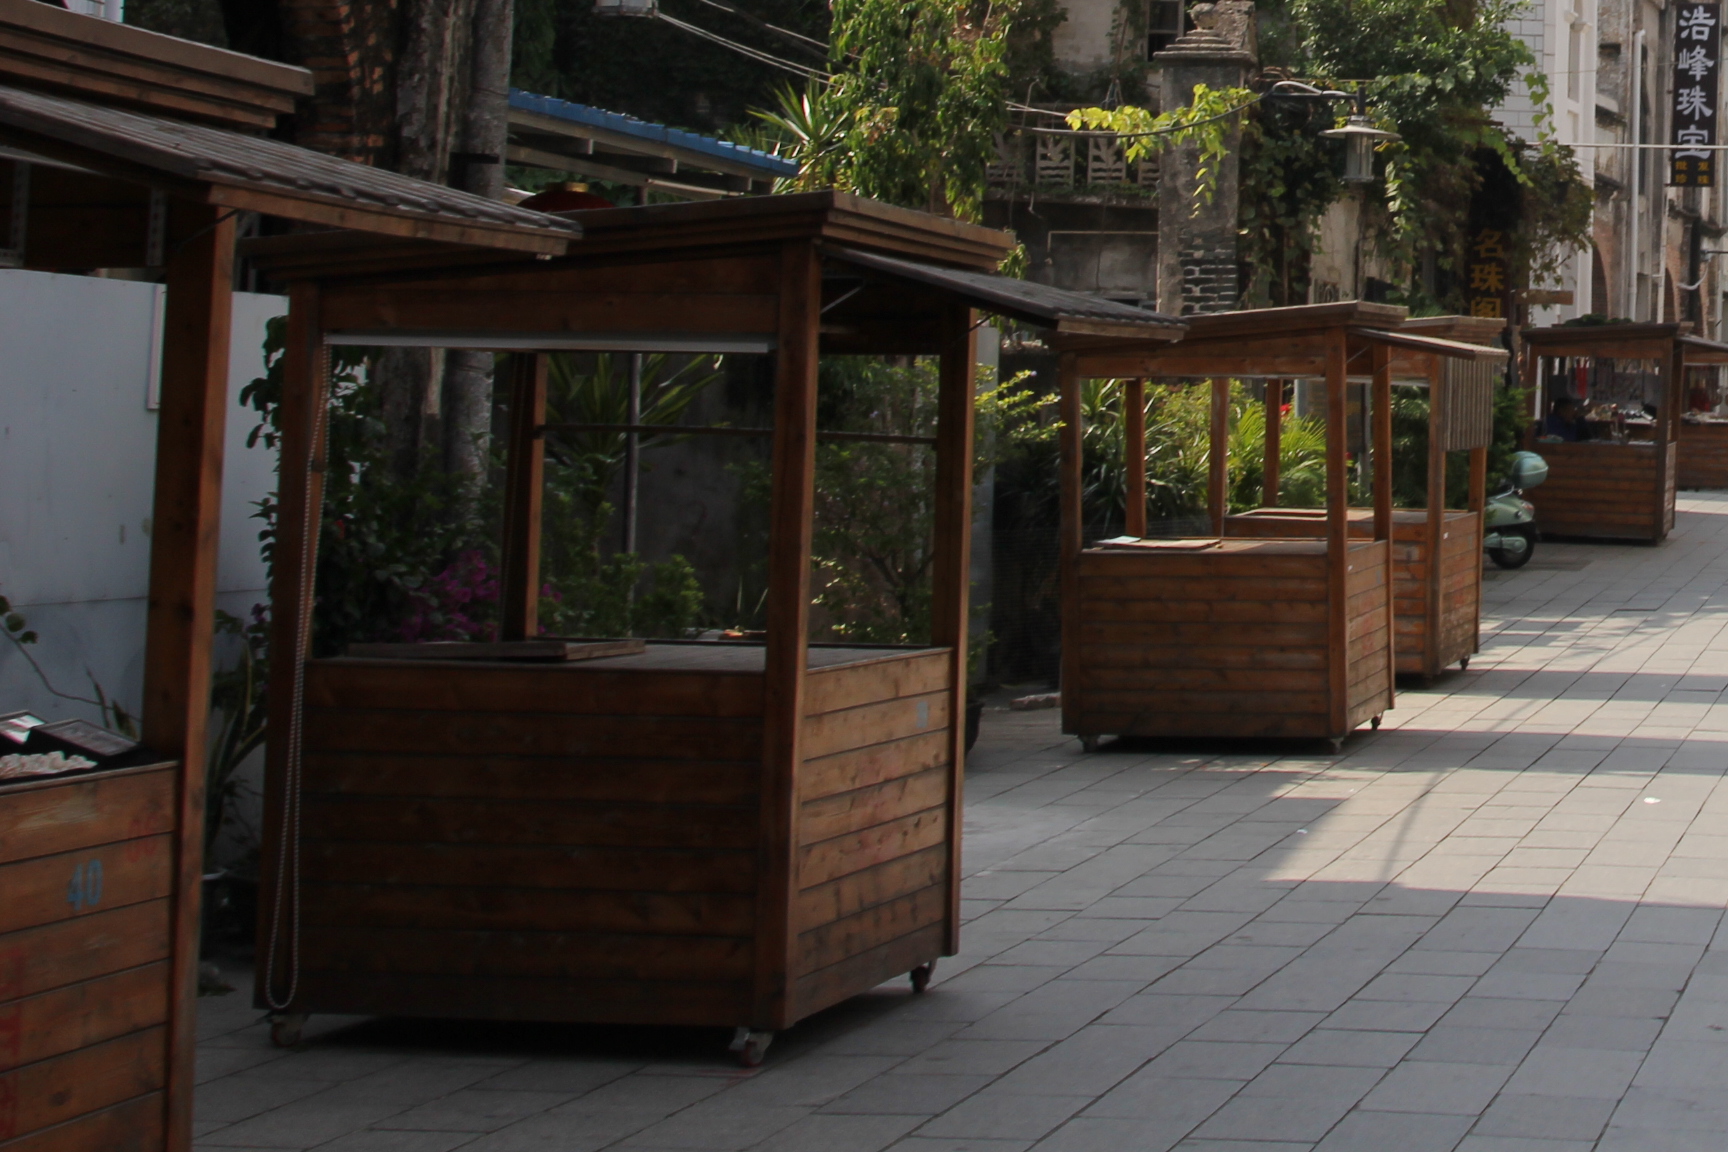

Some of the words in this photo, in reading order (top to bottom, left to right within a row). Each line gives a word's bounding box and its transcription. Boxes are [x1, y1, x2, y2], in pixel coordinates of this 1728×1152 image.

[1674, 5, 1716, 160] 浩峰珠宝
[65, 858, 104, 911] 40
